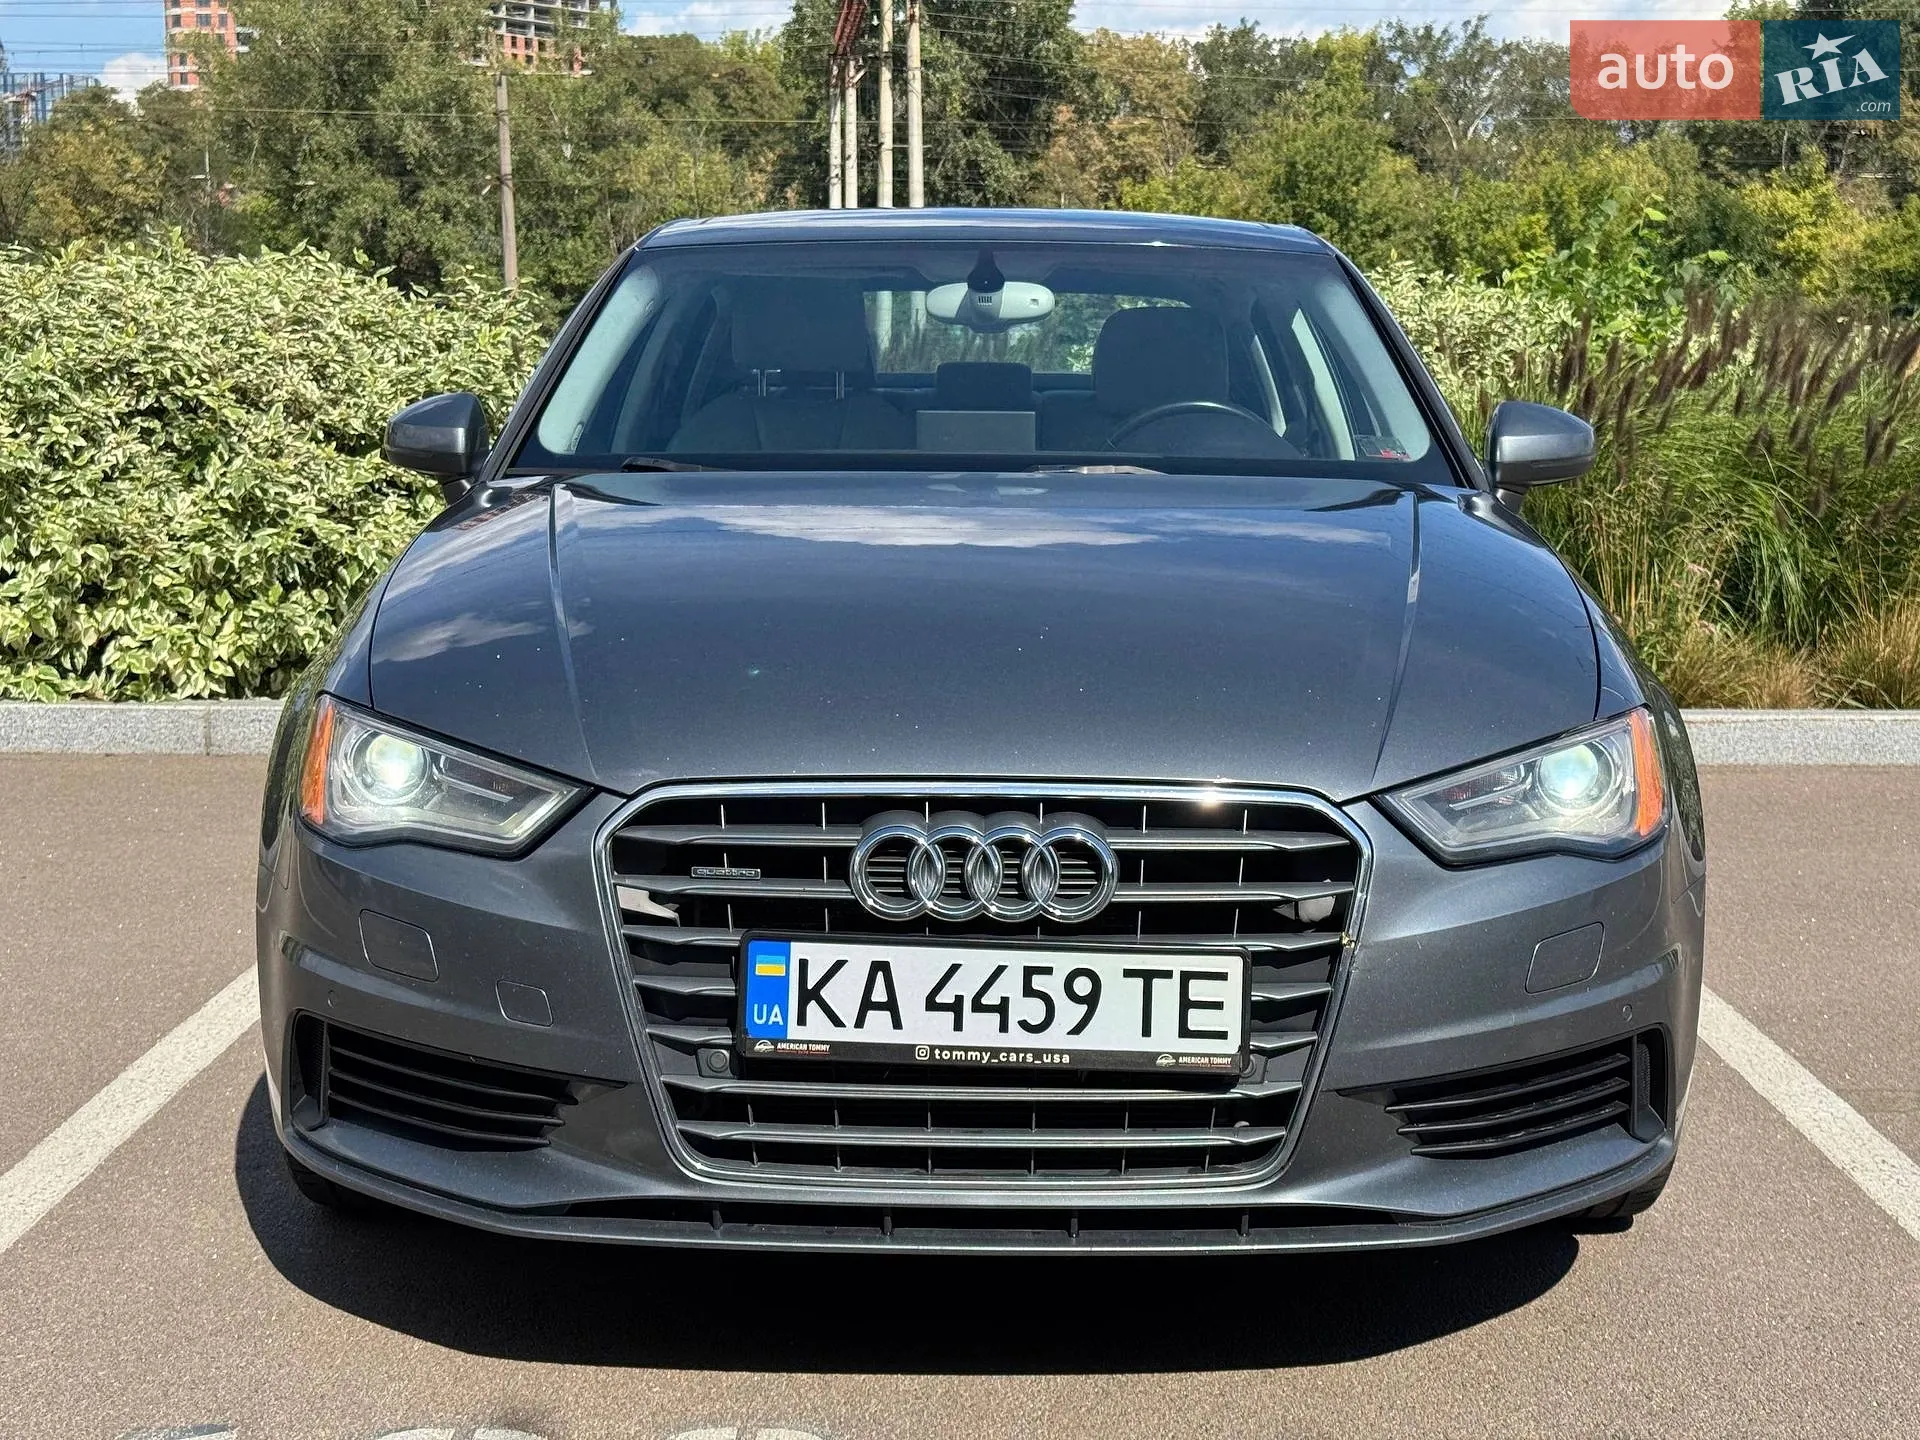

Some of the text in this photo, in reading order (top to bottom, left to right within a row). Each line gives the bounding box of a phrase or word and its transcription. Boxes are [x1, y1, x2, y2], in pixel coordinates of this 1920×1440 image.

[696, 868, 756, 877] quattro
[797, 958, 1229, 1041] KA 4459 TE
[753, 1003, 784, 1026] UA
[776, 1042, 831, 1052] AMERICAN TOMMY
[934, 1048, 1071, 1064] tommy_cars_usa
[1178, 1056, 1232, 1065] AMERICAN TOMMY
